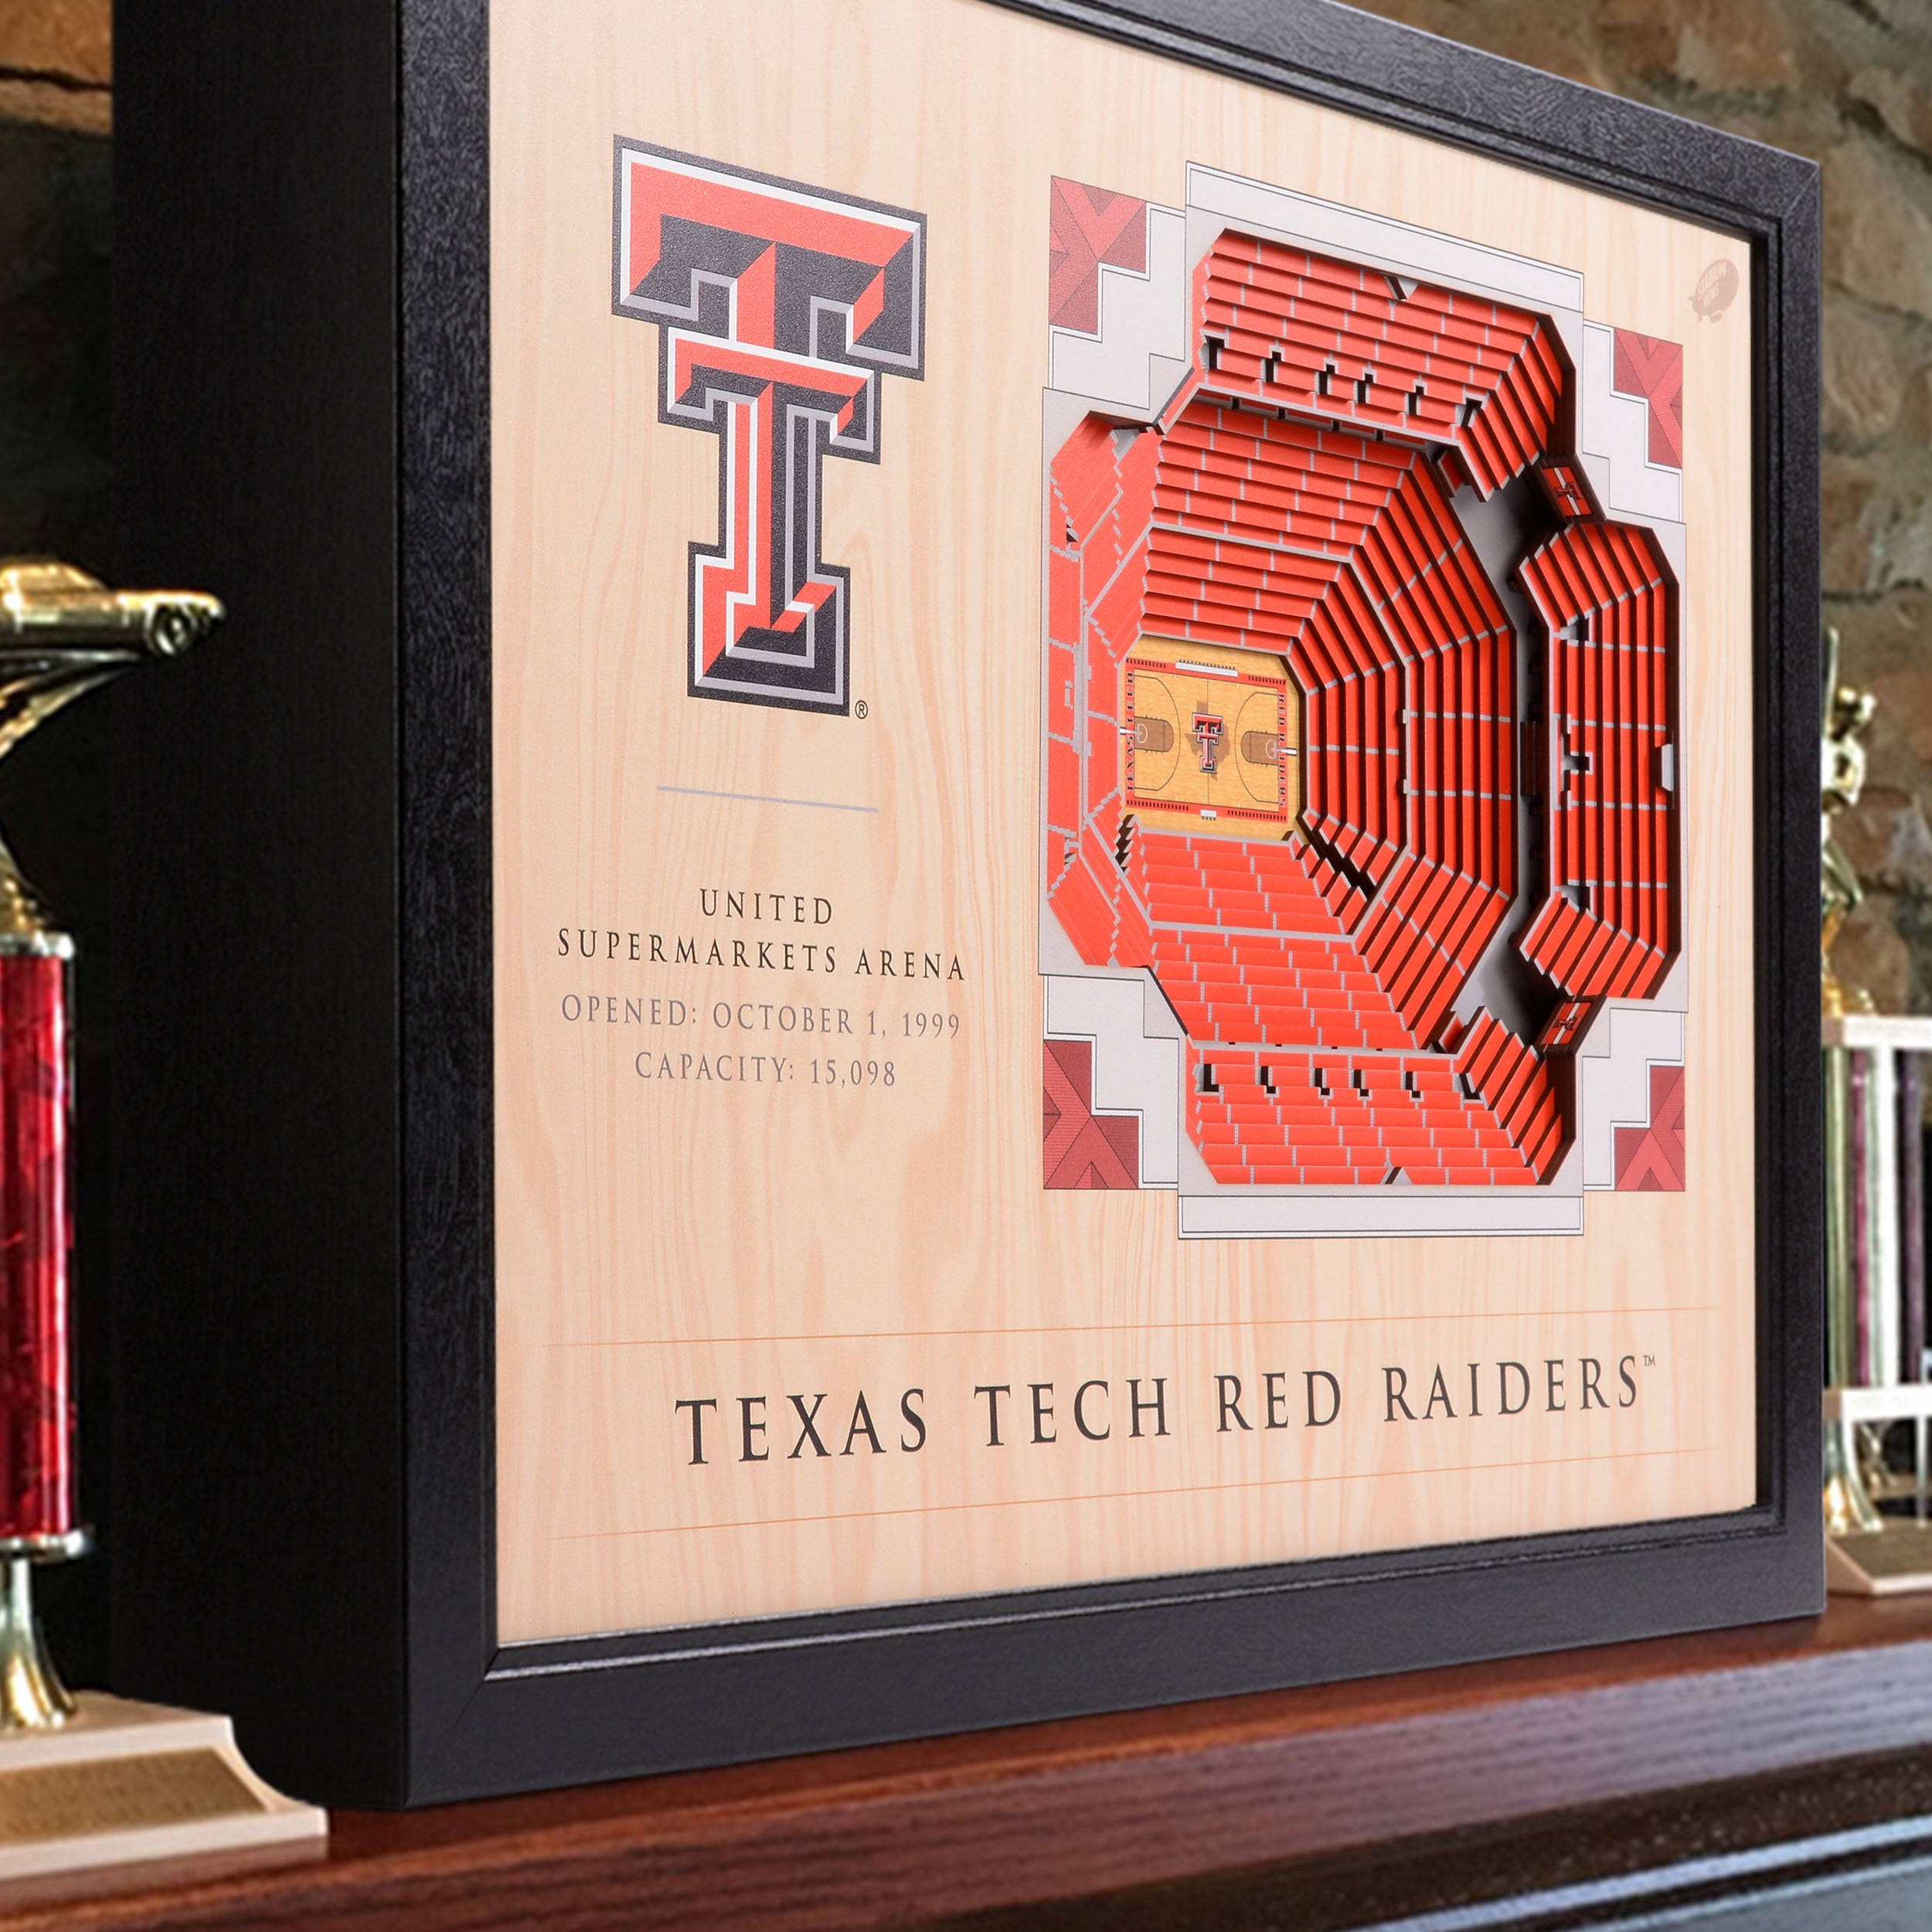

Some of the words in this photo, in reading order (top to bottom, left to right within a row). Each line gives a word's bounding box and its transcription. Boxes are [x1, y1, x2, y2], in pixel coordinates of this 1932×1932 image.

[1126, 672, 1134, 726] TECH
[1277, 693, 1286, 726] RED
[1126, 736, 1134, 792] TEXAS
[699, 888, 832, 925] UNITED
[557, 927, 836, 973] SUPERMARKETS
[854, 947, 965, 981] ARENA
[561, 994, 696, 1026] OPENED:
[713, 1002, 854, 1034] OCTOBER
[867, 1009, 886, 1039] 1,
[902, 1012, 960, 1039] 1999
[635, 1051, 794, 1083] CAPACITY:
[810, 1058, 895, 1089] 15,098
[674, 1388, 927, 1466] TEXAS
[973, 1377, 1172, 1447] TECH
[1213, 1370, 1342, 1434] RED
